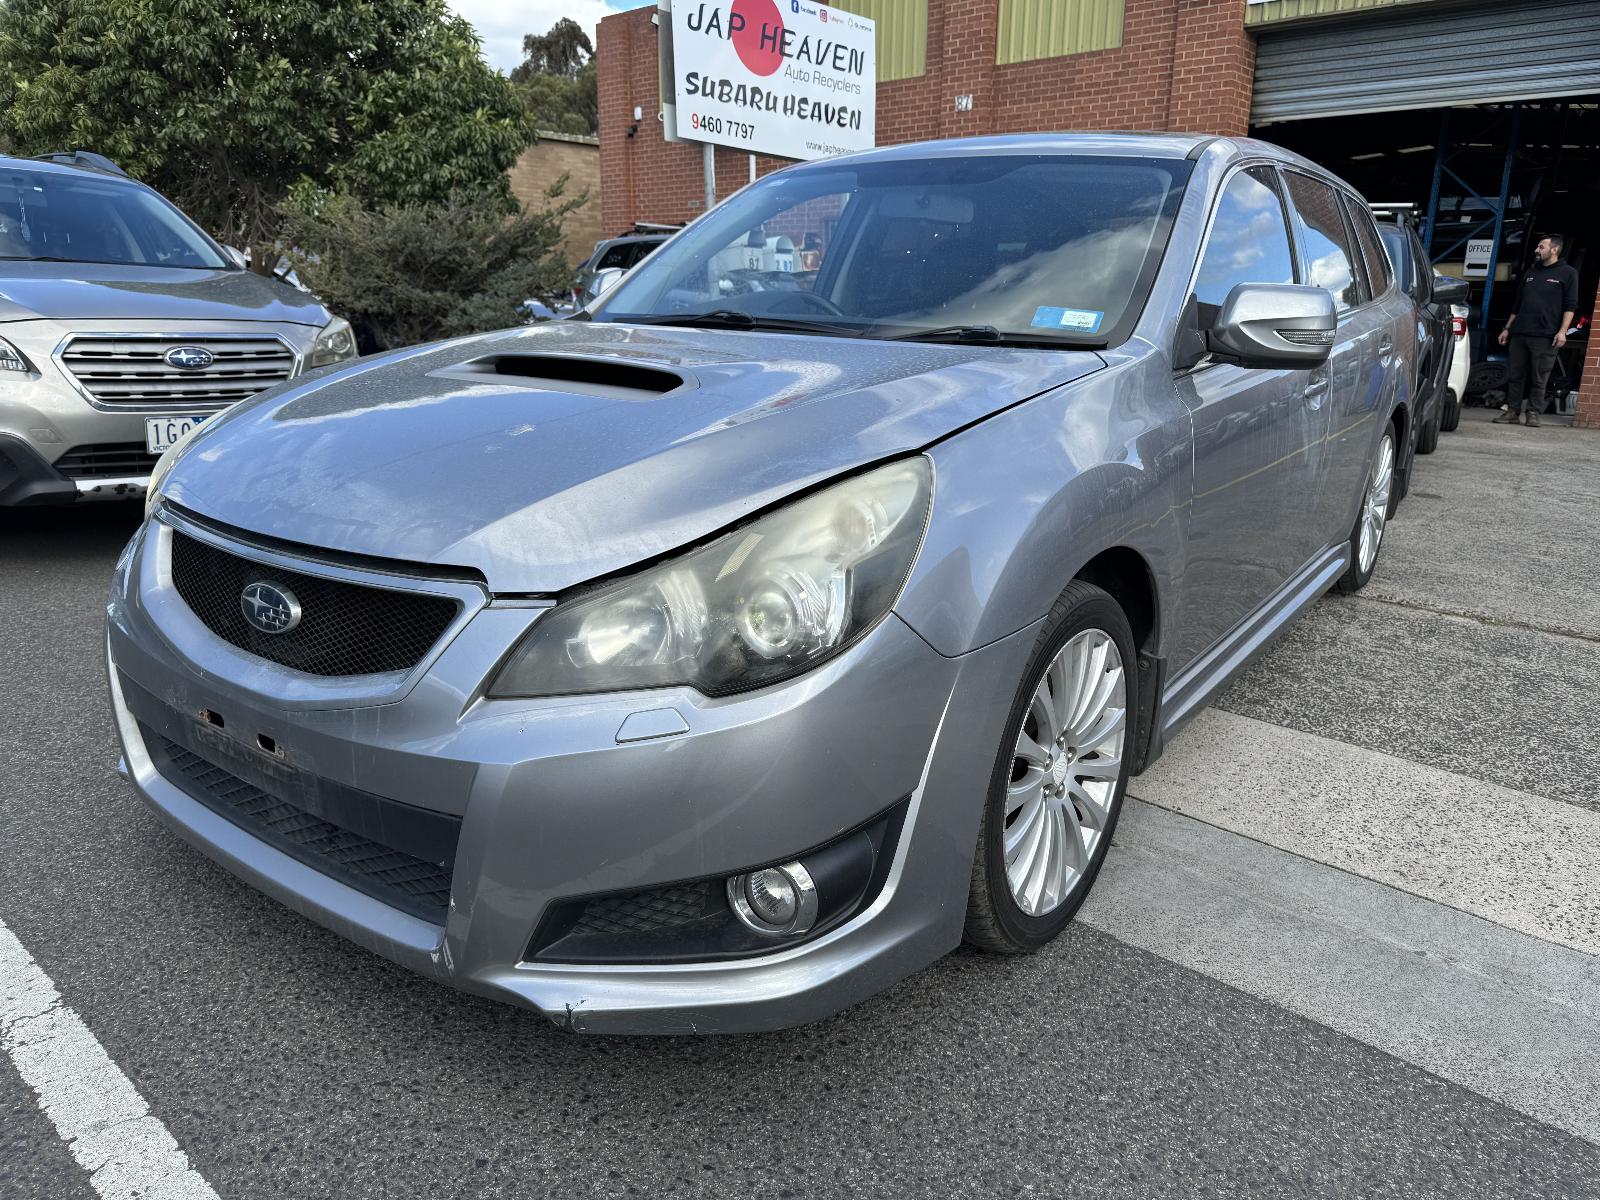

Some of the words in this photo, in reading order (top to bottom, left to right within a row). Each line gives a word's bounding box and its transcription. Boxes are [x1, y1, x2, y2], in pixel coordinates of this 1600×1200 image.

[687, 3, 746, 40] JAP
[760, 22, 865, 76] HEAVEN
[784, 64, 810, 83] Auto
[812, 70, 861, 95] Recyclers
[686, 71, 777, 112] SUBARU
[783, 93, 862, 130] HEAVEN
[692, 113, 722, 134] 9460
[726, 120, 755, 140] 7797
[1468, 244, 1491, 253] OFFICE
